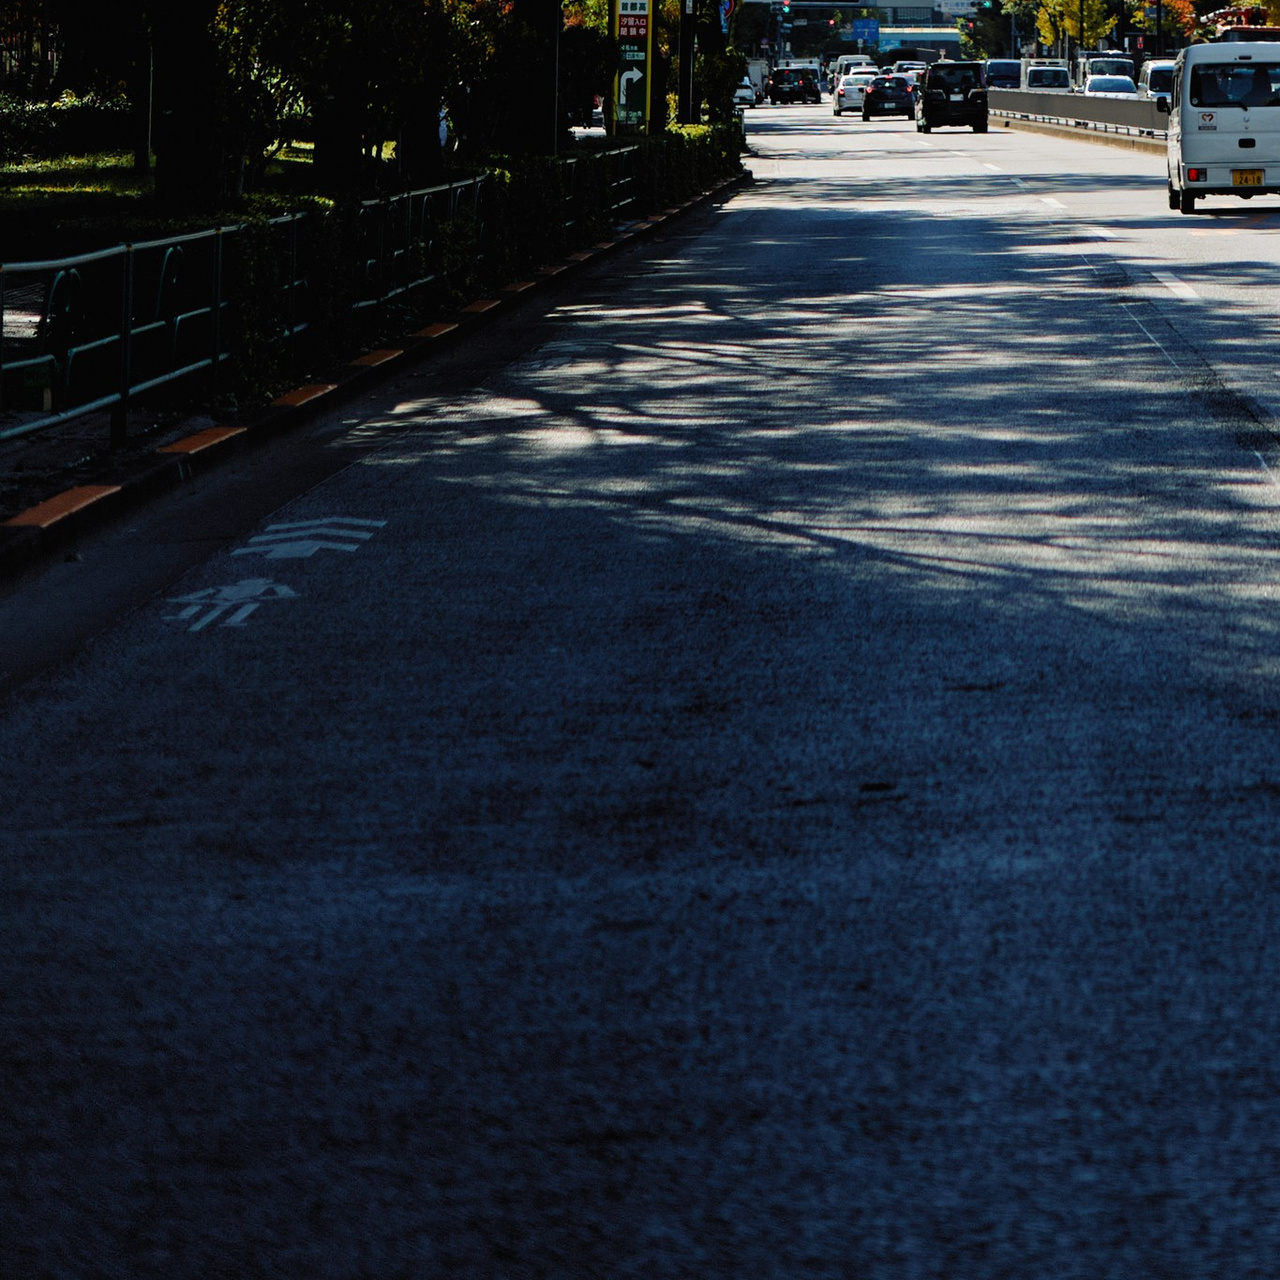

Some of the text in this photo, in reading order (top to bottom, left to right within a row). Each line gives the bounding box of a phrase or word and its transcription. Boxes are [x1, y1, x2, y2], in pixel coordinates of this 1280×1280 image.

[621, 2, 647, 11] 首都高
[620, 17, 646, 26] 汐留入口
